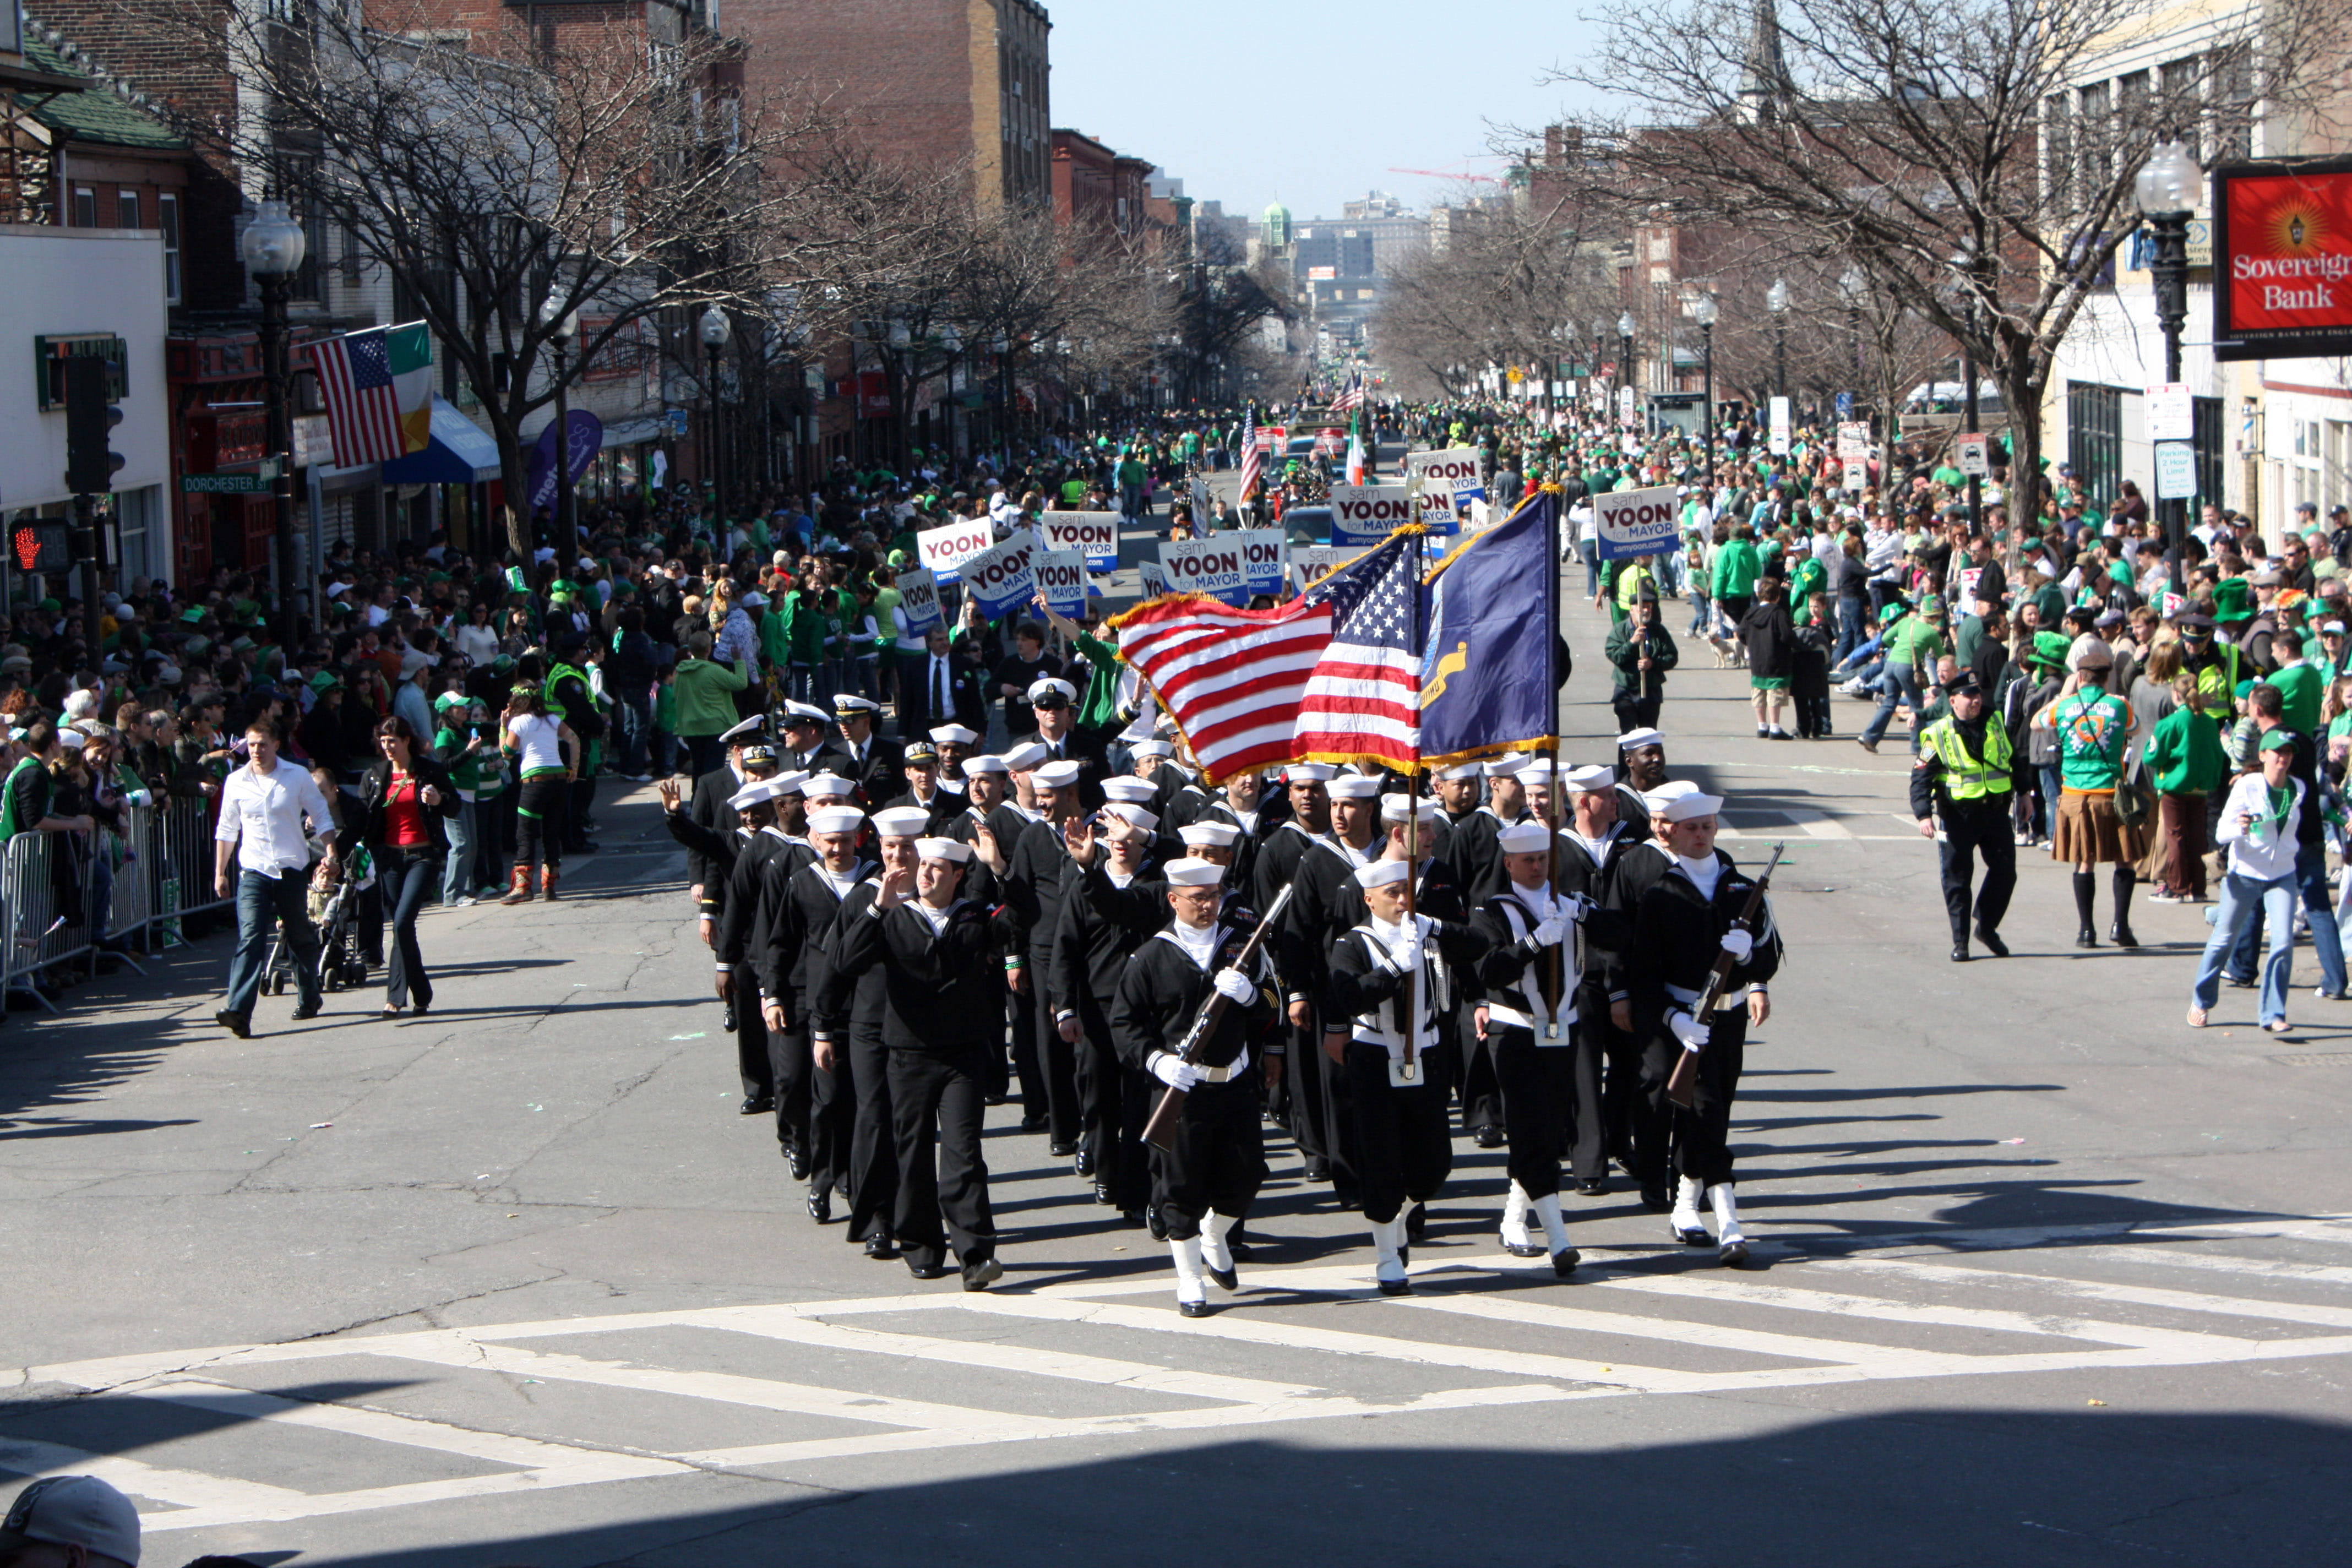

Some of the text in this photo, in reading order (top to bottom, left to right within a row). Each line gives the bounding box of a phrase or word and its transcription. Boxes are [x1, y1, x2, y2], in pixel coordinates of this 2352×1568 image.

[2263, 282, 2335, 311] Bank
[1422, 453, 1449, 465] sam
[186, 476, 253, 491] DORCHESTER
[1349, 488, 1380, 500] sam
[1420, 493, 1449, 510] ON
[1612, 494, 1642, 508] sam
[1338, 500, 1409, 520] YOON
[1422, 511, 1451, 521] AYOR
[1603, 503, 1672, 529] YOON
[1058, 514, 1086, 525] sam
[1347, 520, 1362, 531] for
[1049, 525, 1112, 543] YOON
[1613, 522, 1673, 540] for MAYOR
[925, 531, 987, 559] YOON
[1071, 543, 1112, 554] MAYOR
[1176, 542, 1207, 556] sam
[1243, 543, 1279, 563] ON
[1613, 541, 1665, 553] samyoon.com
[973, 549, 1004, 571] sam
[1041, 553, 1060, 565] sam
[1167, 551, 1239, 578] YOON
[1309, 551, 1338, 562] sam
[970, 544, 1035, 591] YOON
[1035, 565, 1081, 586] YOON
[1299, 563, 1331, 583] YO
[902, 575, 916, 587] sam
[1144, 578, 1164, 598] YO
[1179, 573, 1241, 590] for MAYOR
[901, 582, 934, 608] YOON
[989, 586, 1004, 599] for
[1052, 586, 1081, 598] MAYOR
[917, 602, 936, 618] MAYOR
